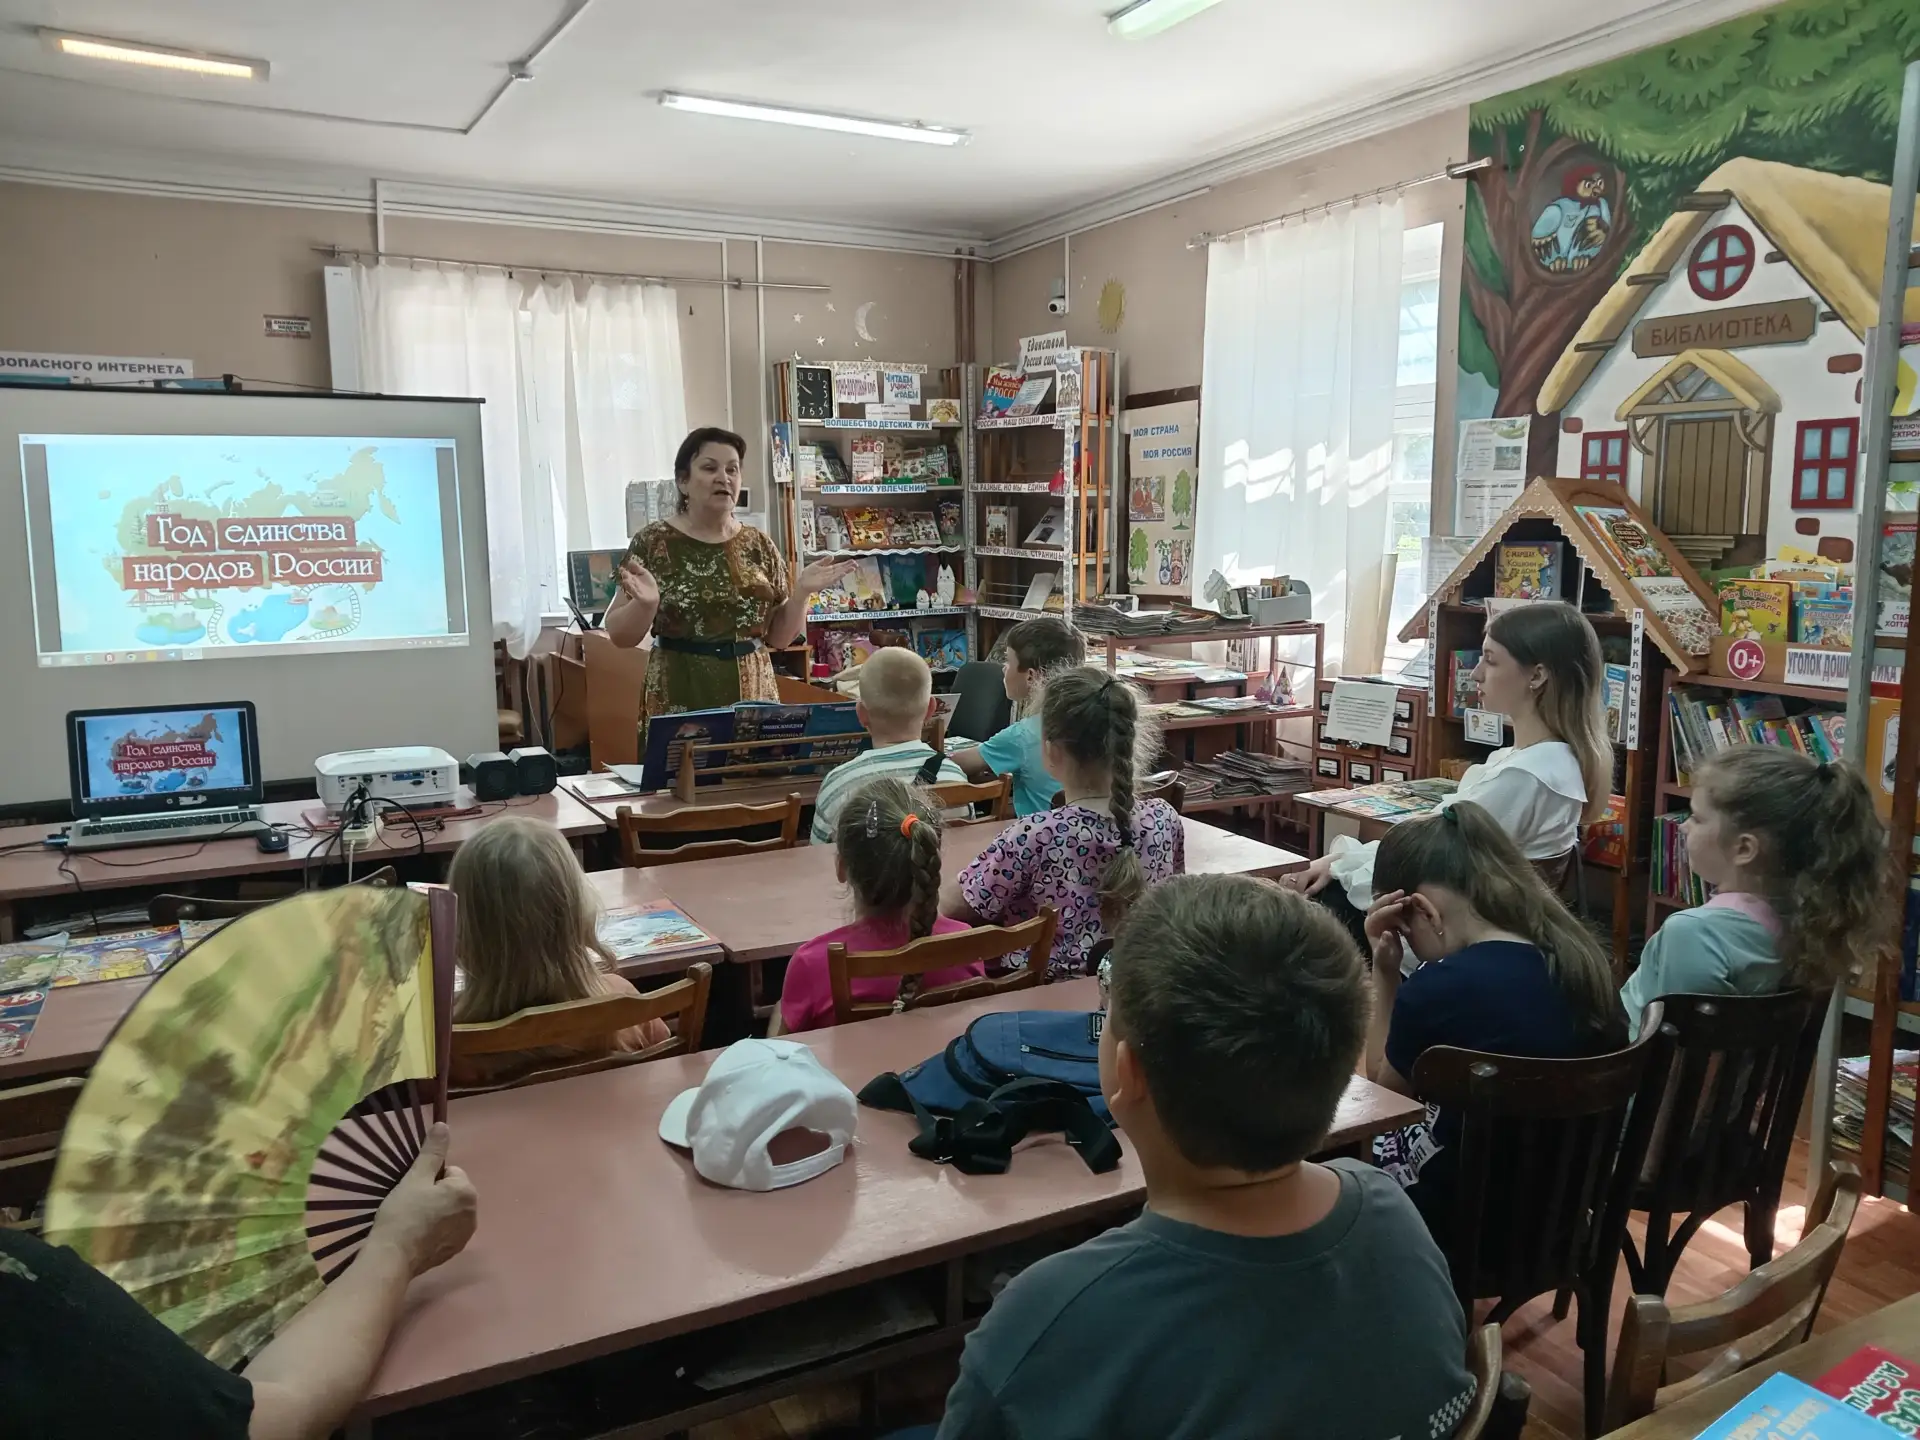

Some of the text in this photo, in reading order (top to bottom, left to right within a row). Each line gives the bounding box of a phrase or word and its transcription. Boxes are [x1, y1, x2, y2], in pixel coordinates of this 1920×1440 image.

[1651, 313, 1793, 347] БИБЛИОТЕКА
[98, 361, 185, 375] ИНТЕРНЕТА
[825, 419, 930, 429] ВОЛШЕБСТВО ДЕТСКИХ РУК
[1003, 417, 1018, 426] НАШ
[1041, 415, 1056, 425] ДОМ
[1133, 424, 1180, 437] МОЯ СТРАНА
[1143, 446, 1192, 459] МОЯ РОССИЯ
[822, 485, 840, 493] МИР
[844, 485, 874, 493] ТВОИХ
[156, 517, 348, 547] Год единства
[1030, 551, 1064, 560] СТРАНИЦЫ
[132, 552, 376, 590] народов России
[809, 612, 860, 622] ТВОРЧЕСКИЕ
[861, 610, 899, 619] ПОДЕЛКИ
[900, 607, 948, 616] УЧАСТНИКОВ
[1428, 599, 1437, 714] ПРОДОЛЖЕНИЕ
[1734, 648, 1761, 669] 0+
[1787, 651, 1823, 678] УГОЛОК
[1628, 611, 1642, 744] ПРИКЛЮЧЕНИЙ
[126, 744, 202, 756] Год единства
[117, 756, 213, 773] народов России
